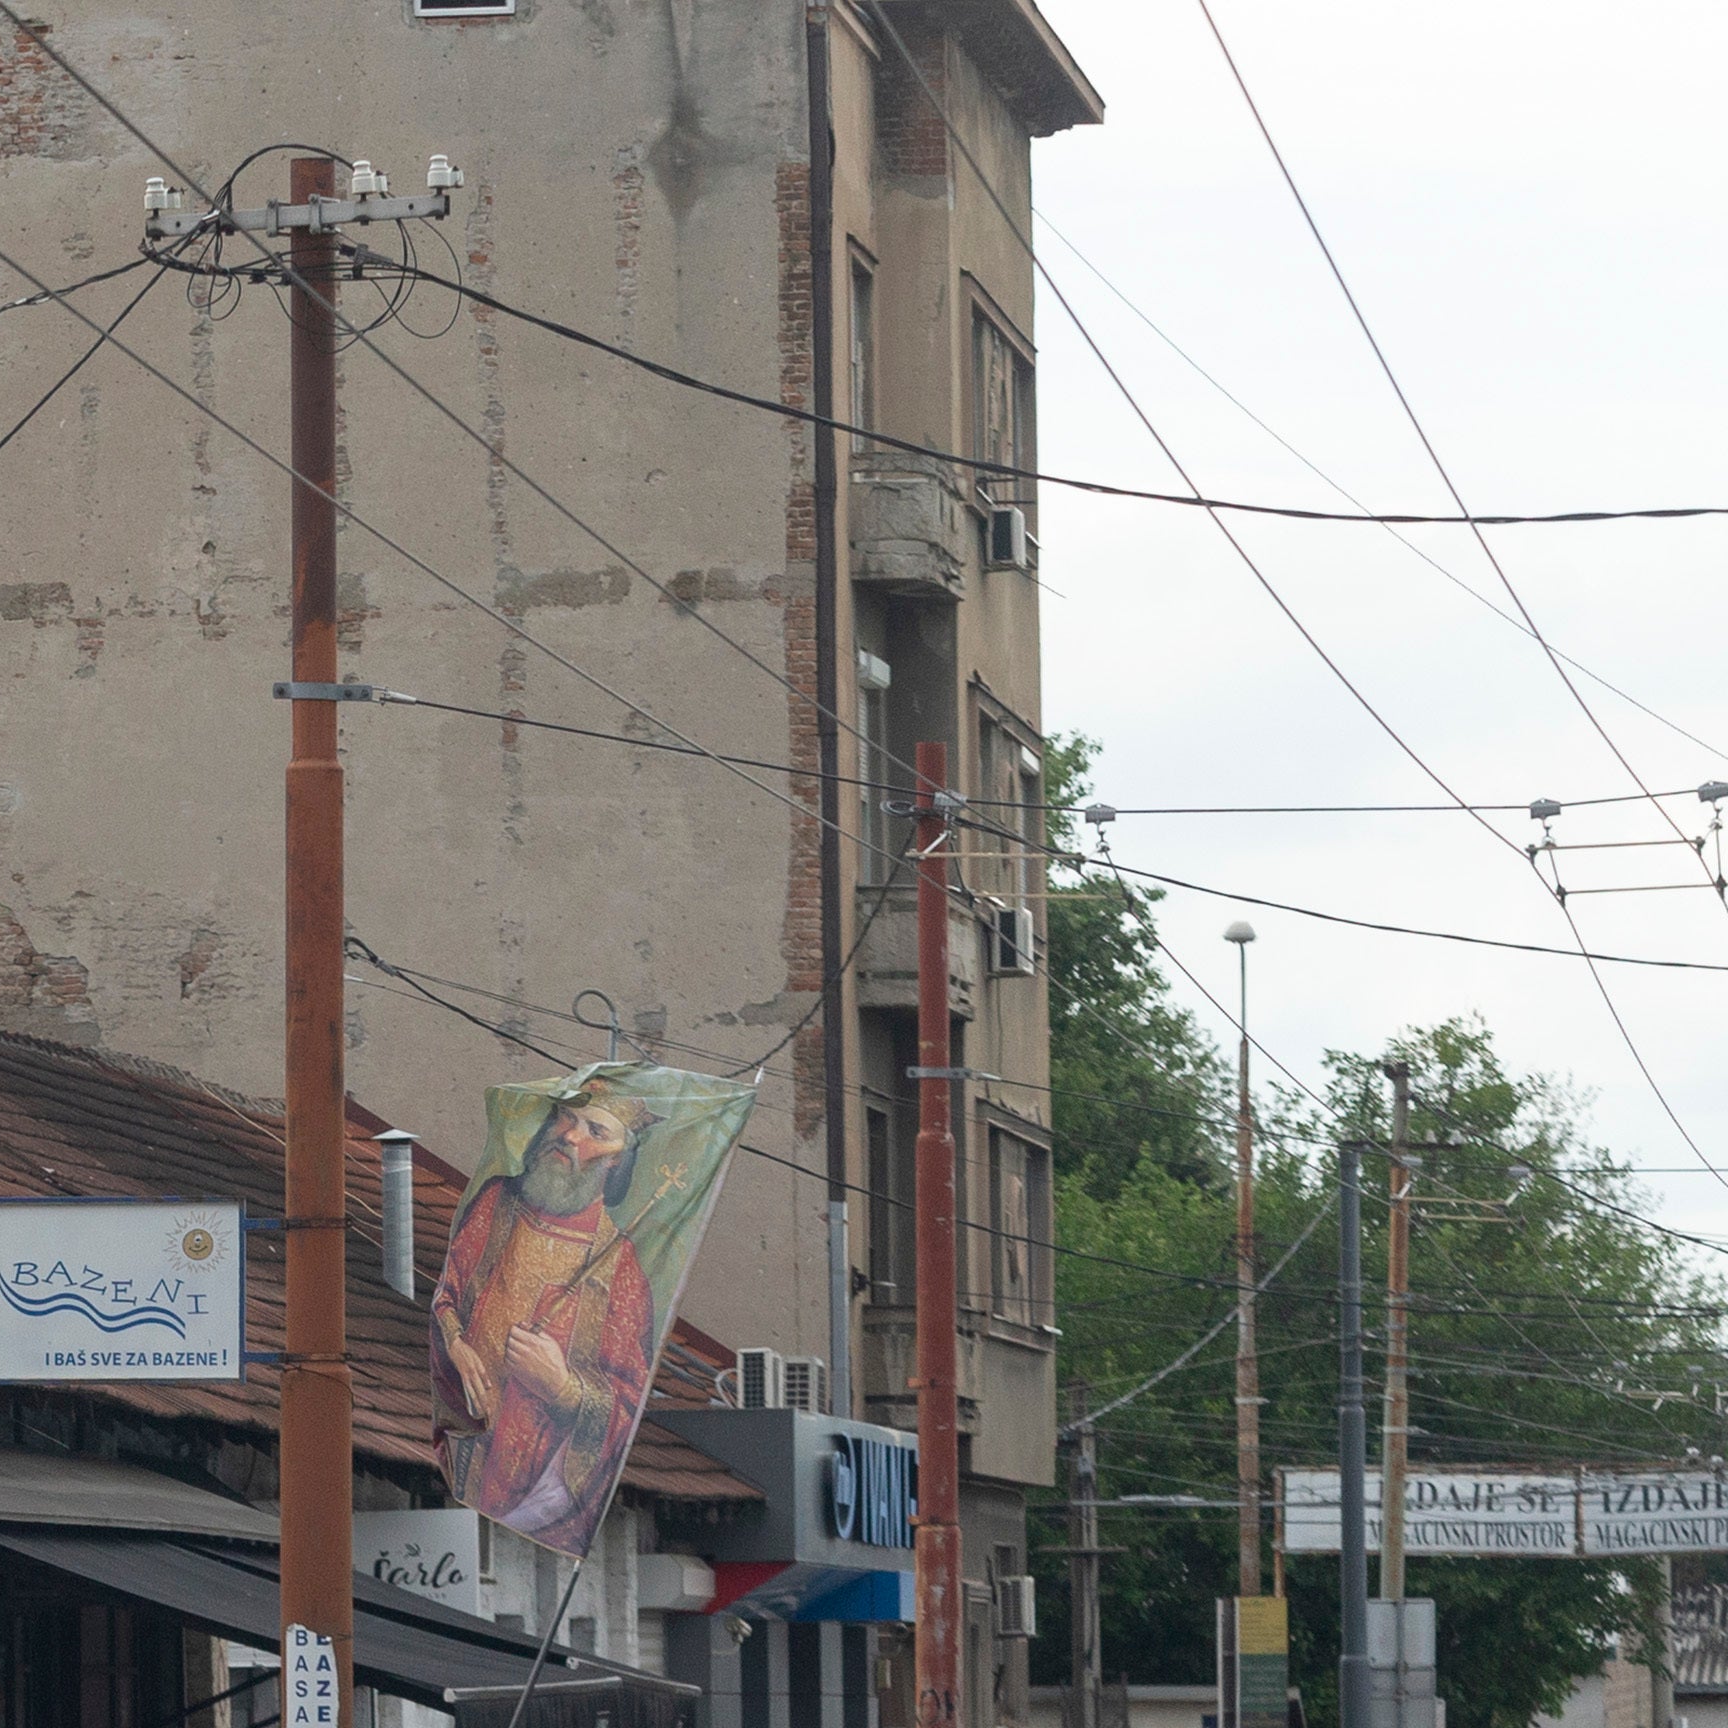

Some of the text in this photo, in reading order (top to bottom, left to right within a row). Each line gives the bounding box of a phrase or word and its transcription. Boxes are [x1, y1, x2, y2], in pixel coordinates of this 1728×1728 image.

[11, 1261, 209, 1314] BAZENI
[54, 1350, 87, 1366] BAŠ
[90, 1352, 122, 1366] SVE
[126, 1352, 148, 1366] ZA
[1379, 1481, 1505, 1511] DAJE
[1369, 1520, 1566, 1548] MACINSKI PROSTOR
